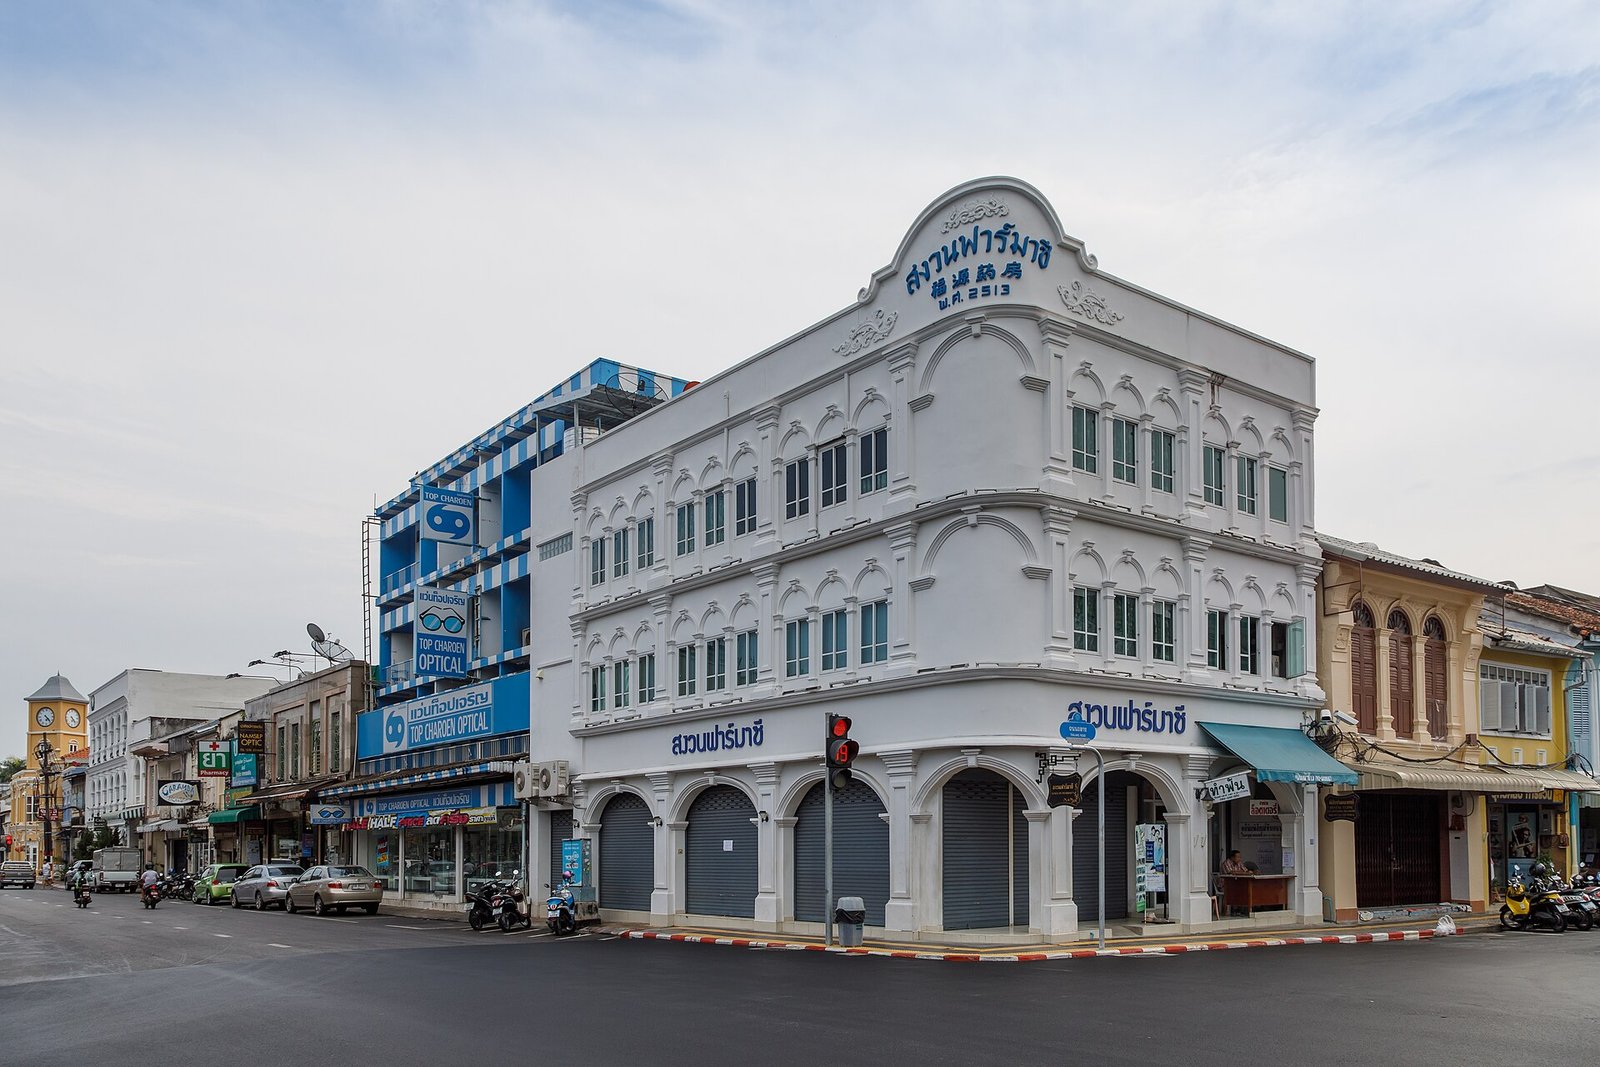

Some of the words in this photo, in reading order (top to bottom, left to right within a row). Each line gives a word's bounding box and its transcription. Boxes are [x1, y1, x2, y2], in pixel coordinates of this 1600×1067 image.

[938, 291, 964, 311] พ.ศ.
[968, 284, 1011, 300] 2513
[425, 491, 438, 501] TOP
[440, 495, 472, 507] CHAROEN
[419, 637, 433, 651] TOP
[434, 639, 465, 654] CHAROEN
[418, 653, 465, 675] OPTICAL
[410, 690, 489, 720] แว่นท็อปเจริญ
[410, 724, 424, 744] TOP
[424, 718, 456, 741] CHAROEN
[457, 711, 488, 734] OPTICAL
[672, 718, 764, 756] สงวนฟาร์มาซี
[240, 738, 263, 747] OPTIC
[202, 752, 226, 768] ยา
[1209, 776, 1246, 797] ทำฟัน
[378, 802, 388, 811] TOP
[370, 815, 398, 830] HALF
